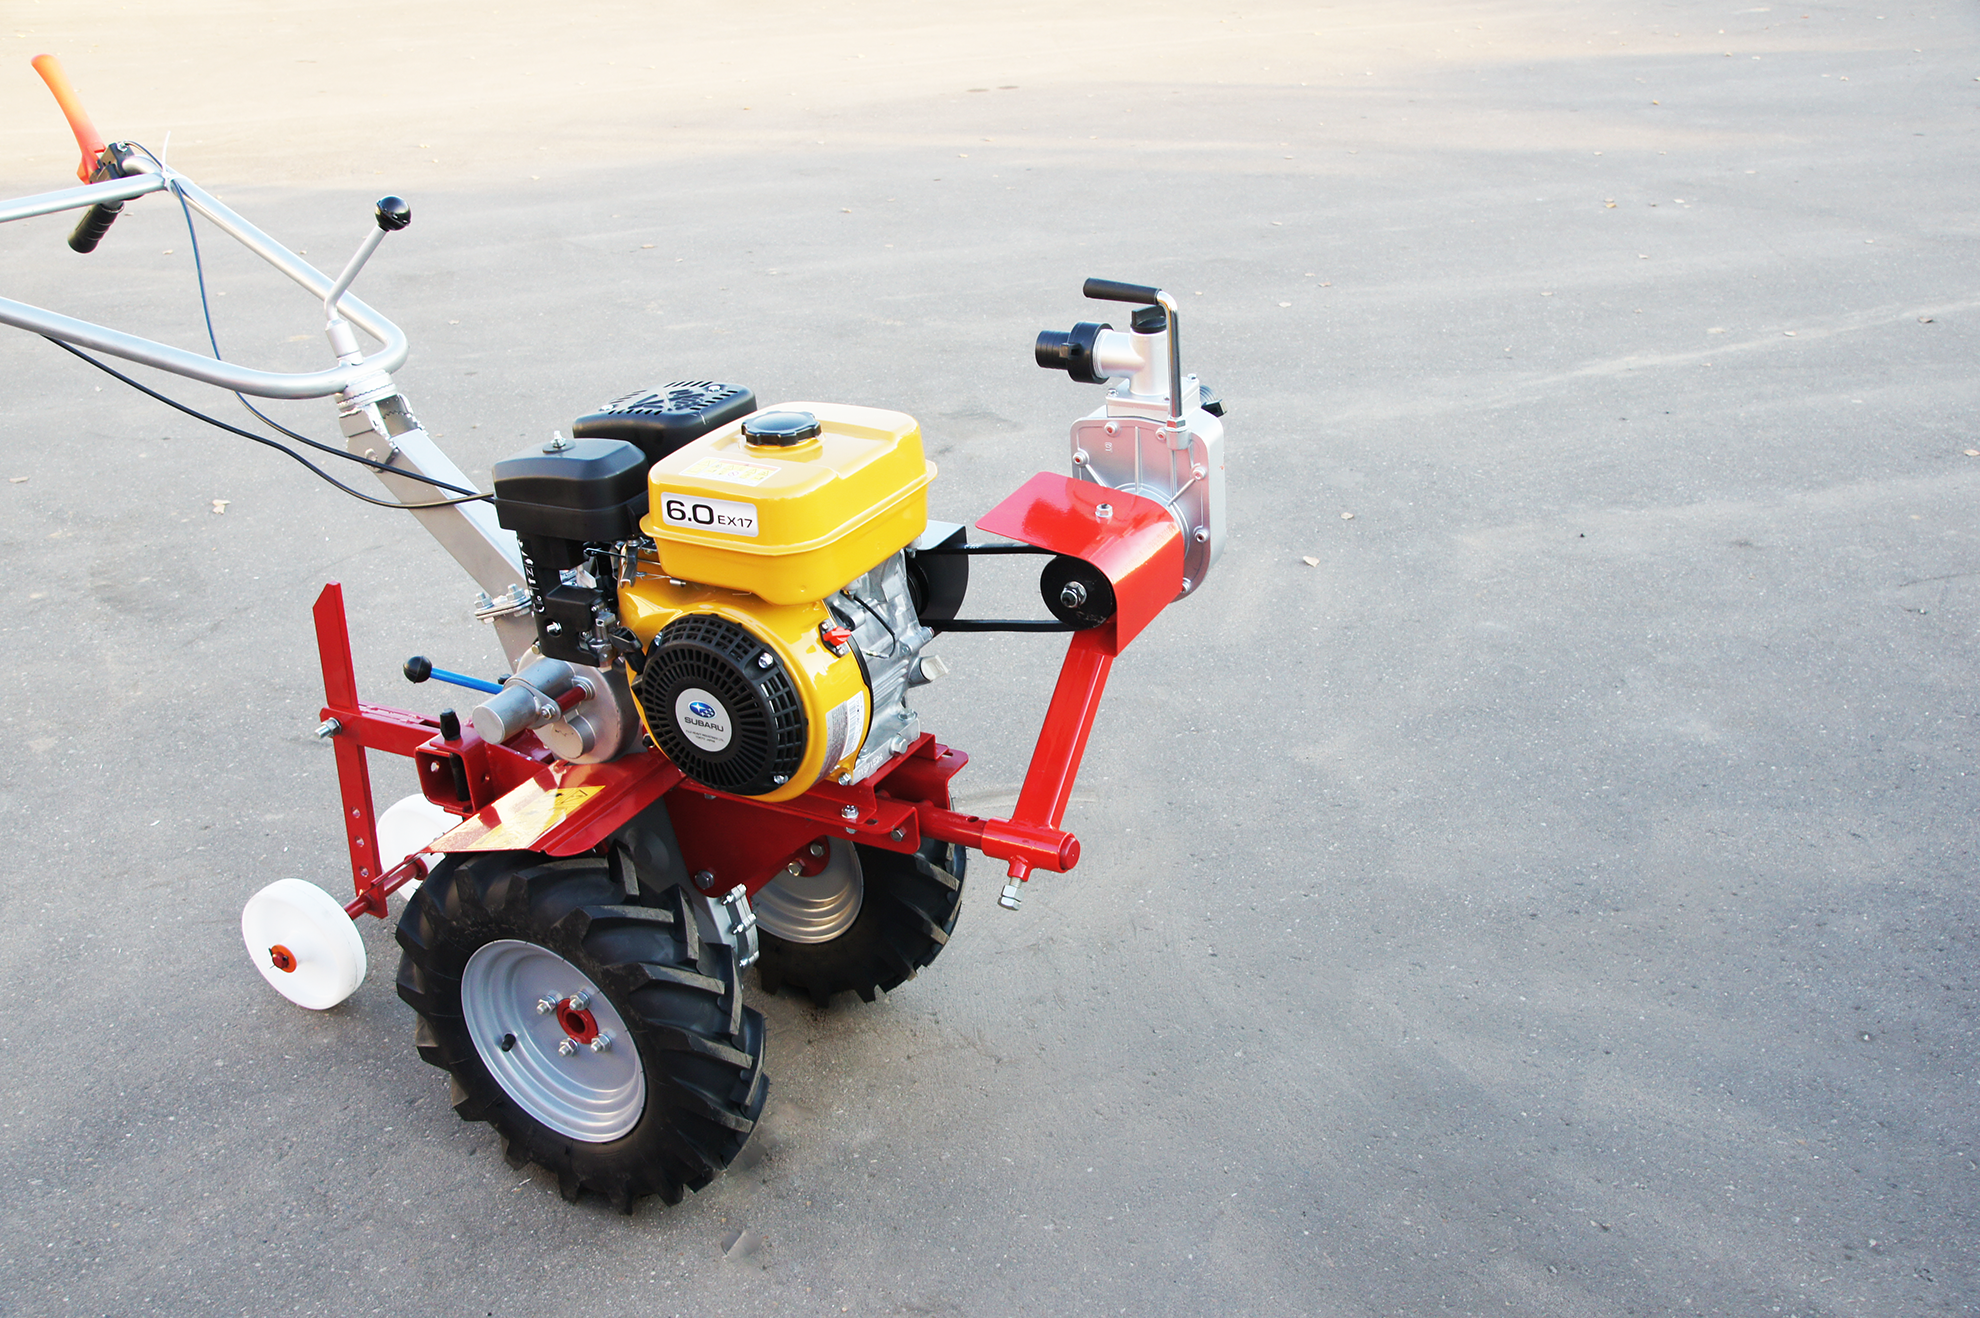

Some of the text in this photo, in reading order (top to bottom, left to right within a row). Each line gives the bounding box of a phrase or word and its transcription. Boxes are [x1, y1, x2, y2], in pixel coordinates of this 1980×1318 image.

[666, 500, 753, 529] 6.0 EX17
[684, 716, 724, 732] SUBARU
